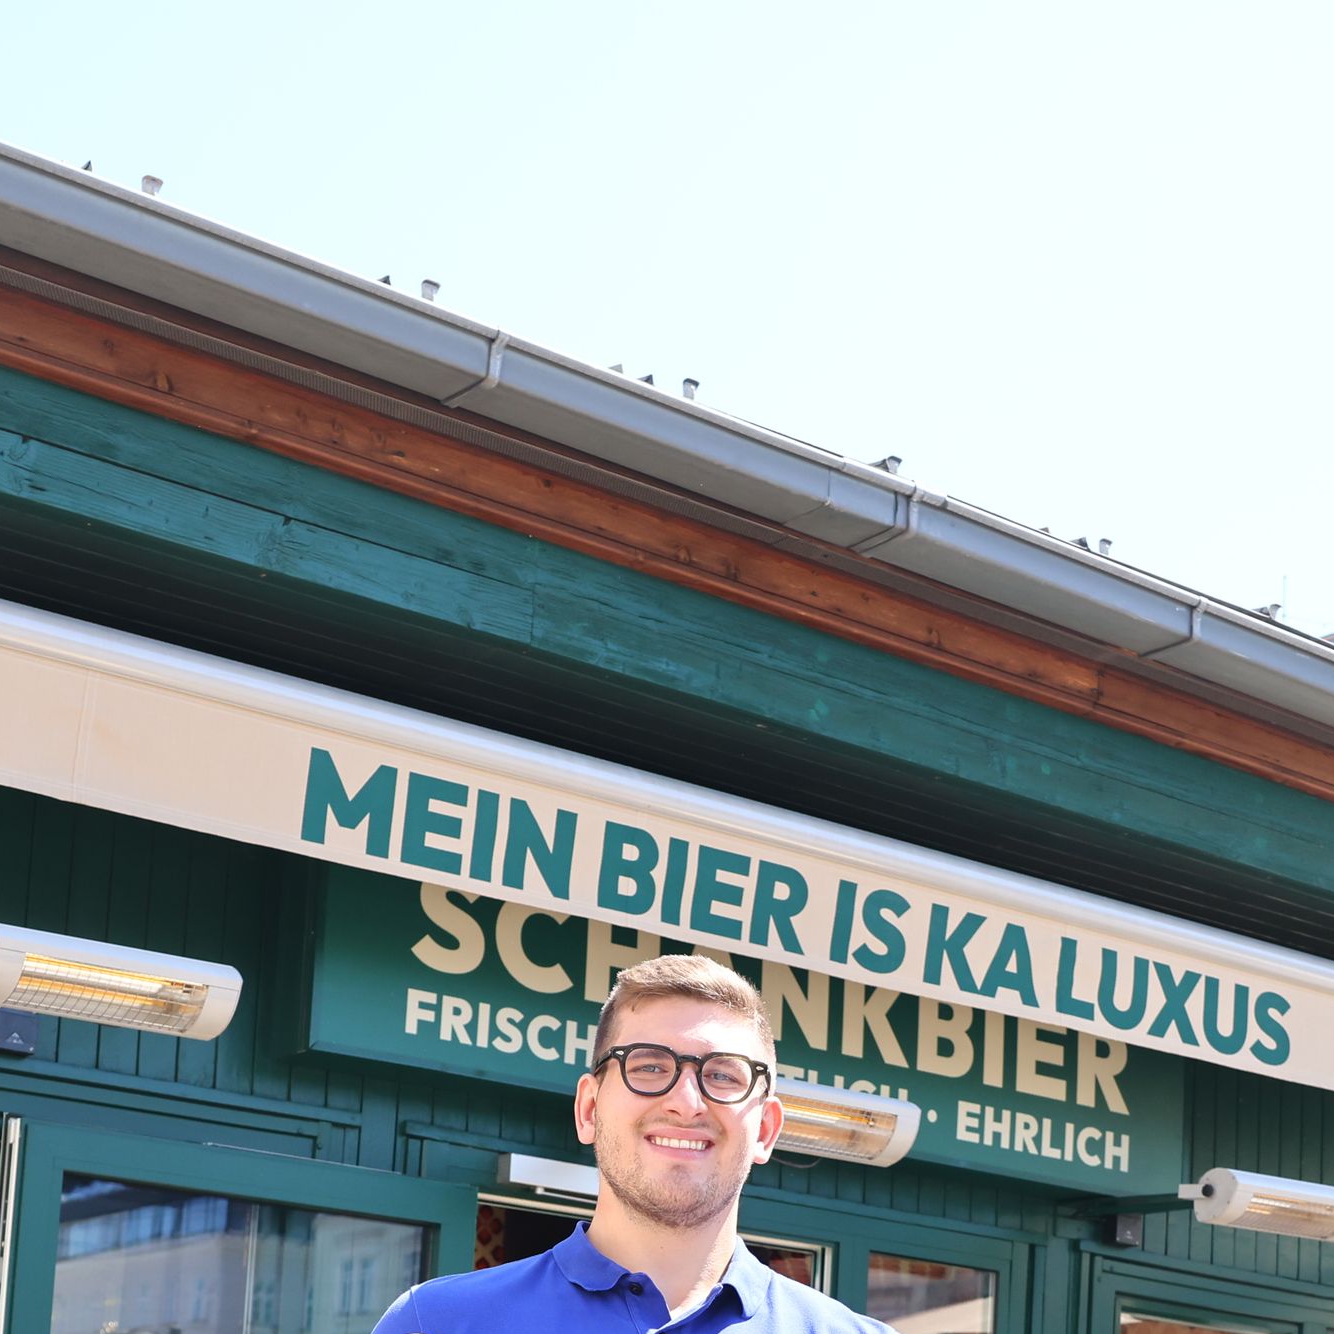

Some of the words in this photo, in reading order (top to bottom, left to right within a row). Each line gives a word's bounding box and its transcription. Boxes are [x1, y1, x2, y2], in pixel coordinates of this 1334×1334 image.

[301, 746, 578, 900] MEIN
[597, 820, 809, 955] BIER
[829, 879, 911, 973] IS
[922, 903, 1040, 1008] KA
[1055, 936, 1292, 1066] LUXUS
[411, 880, 1130, 1116] SCHNKBIER
[405, 987, 597, 1067] FRISCH
[956, 1100, 1130, 1172] EHRLICH
